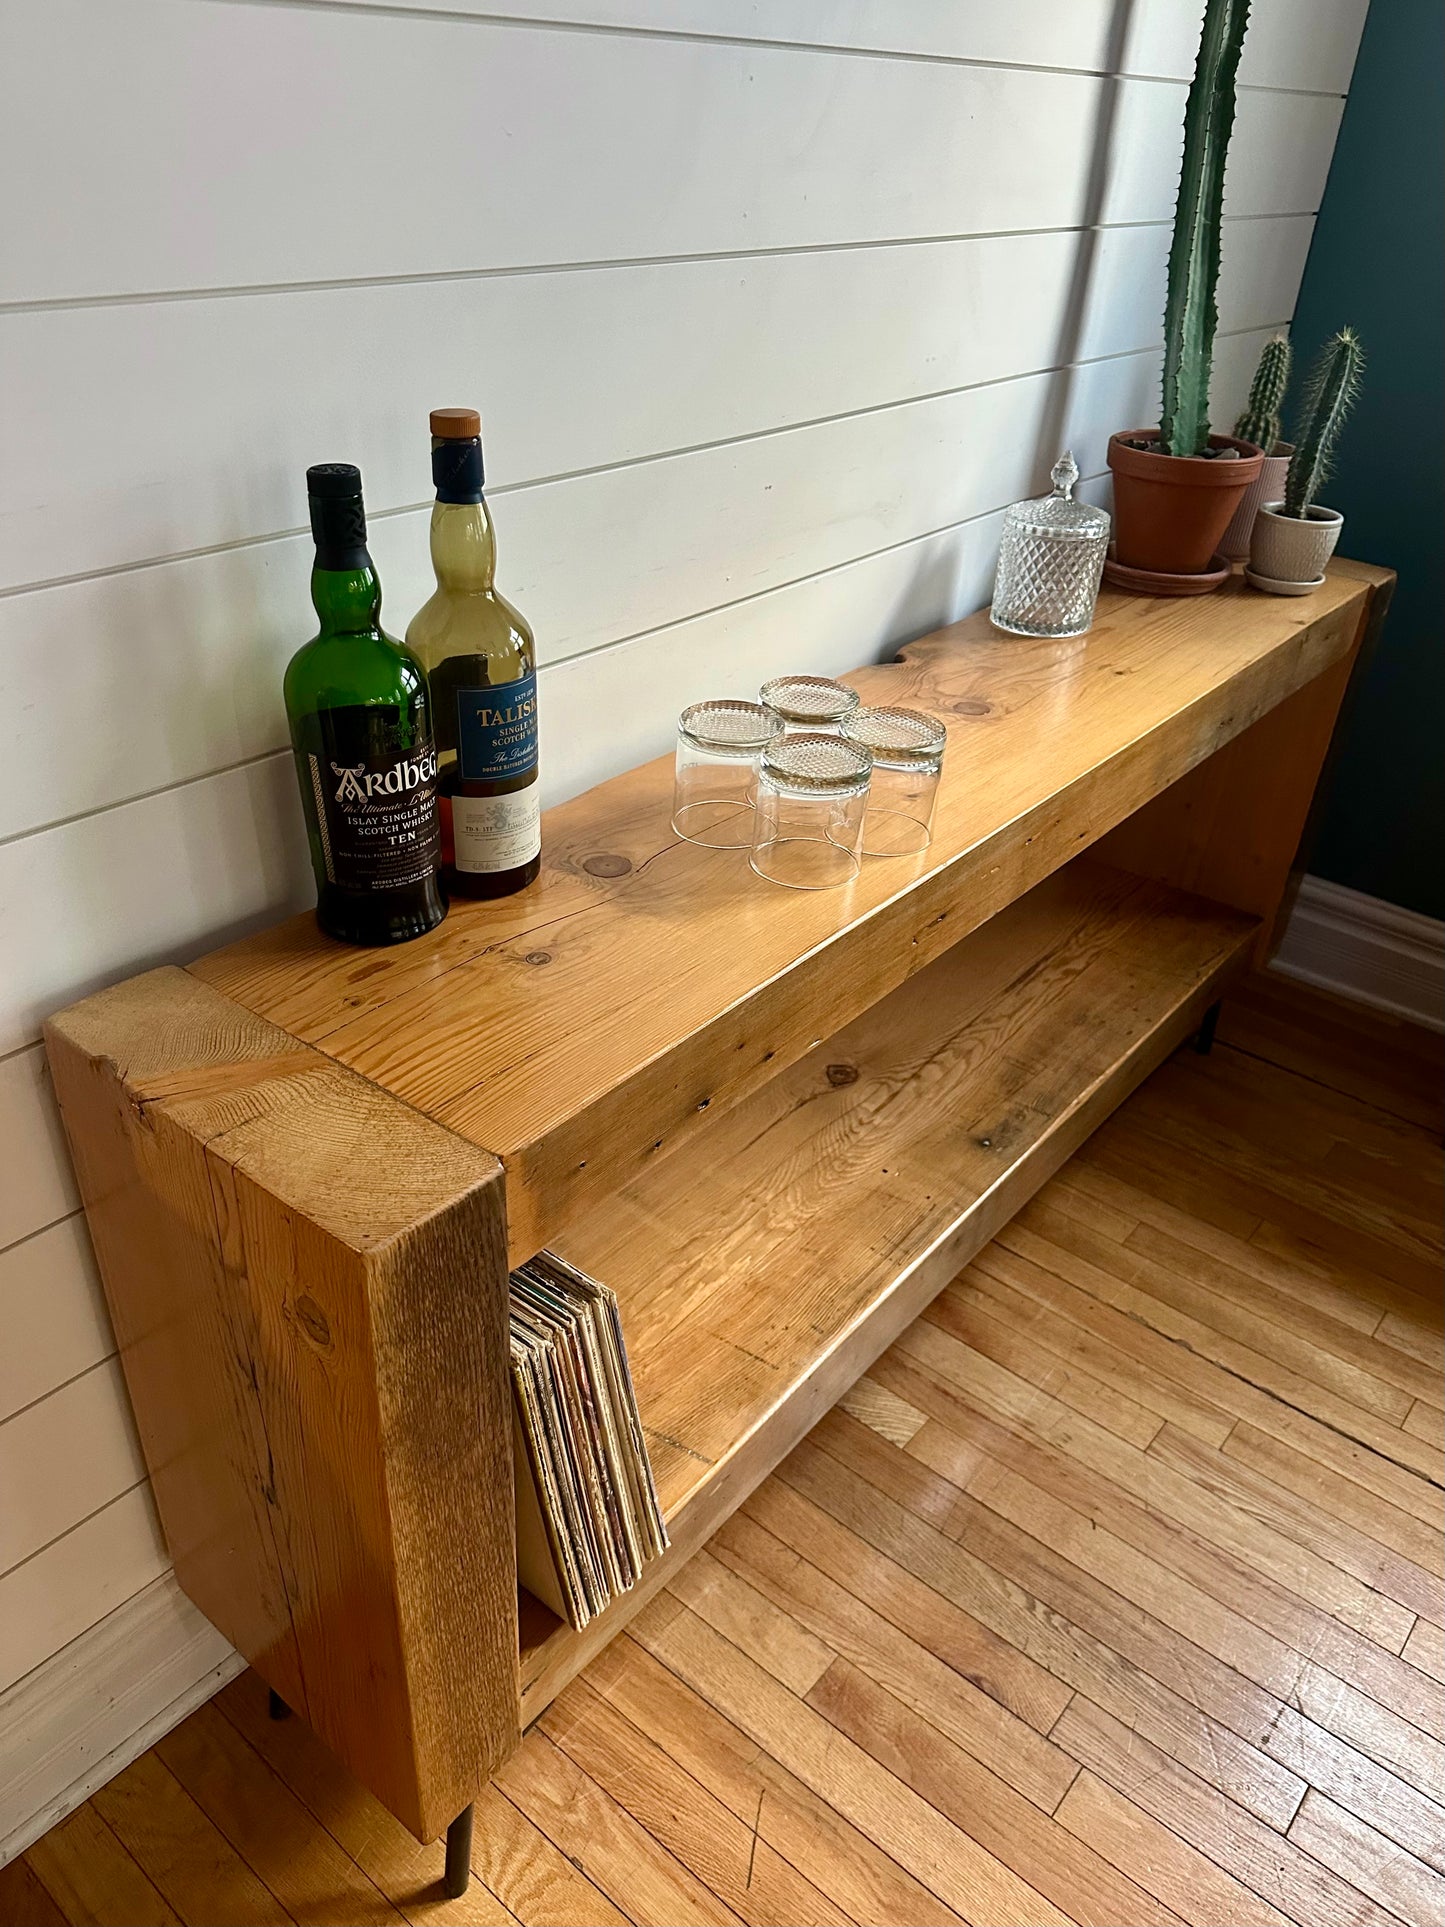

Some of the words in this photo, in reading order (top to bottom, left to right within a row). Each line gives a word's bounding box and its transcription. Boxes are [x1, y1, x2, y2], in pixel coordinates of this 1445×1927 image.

[499, 721, 528, 736] SINGLE
[491, 731, 526, 747] SCOTCH
[489, 751, 508, 764] The
[341, 803, 358, 813] The
[361, 803, 403, 814] Ultimate
[347, 816, 379, 825] ISLAY
[382, 808, 418, 824] SINGLE
[420, 795, 436, 813] MALT
[357, 824, 399, 836] SCOTCH
[402, 809, 433, 830] WHISKY
[387, 830, 416, 846] TEN
